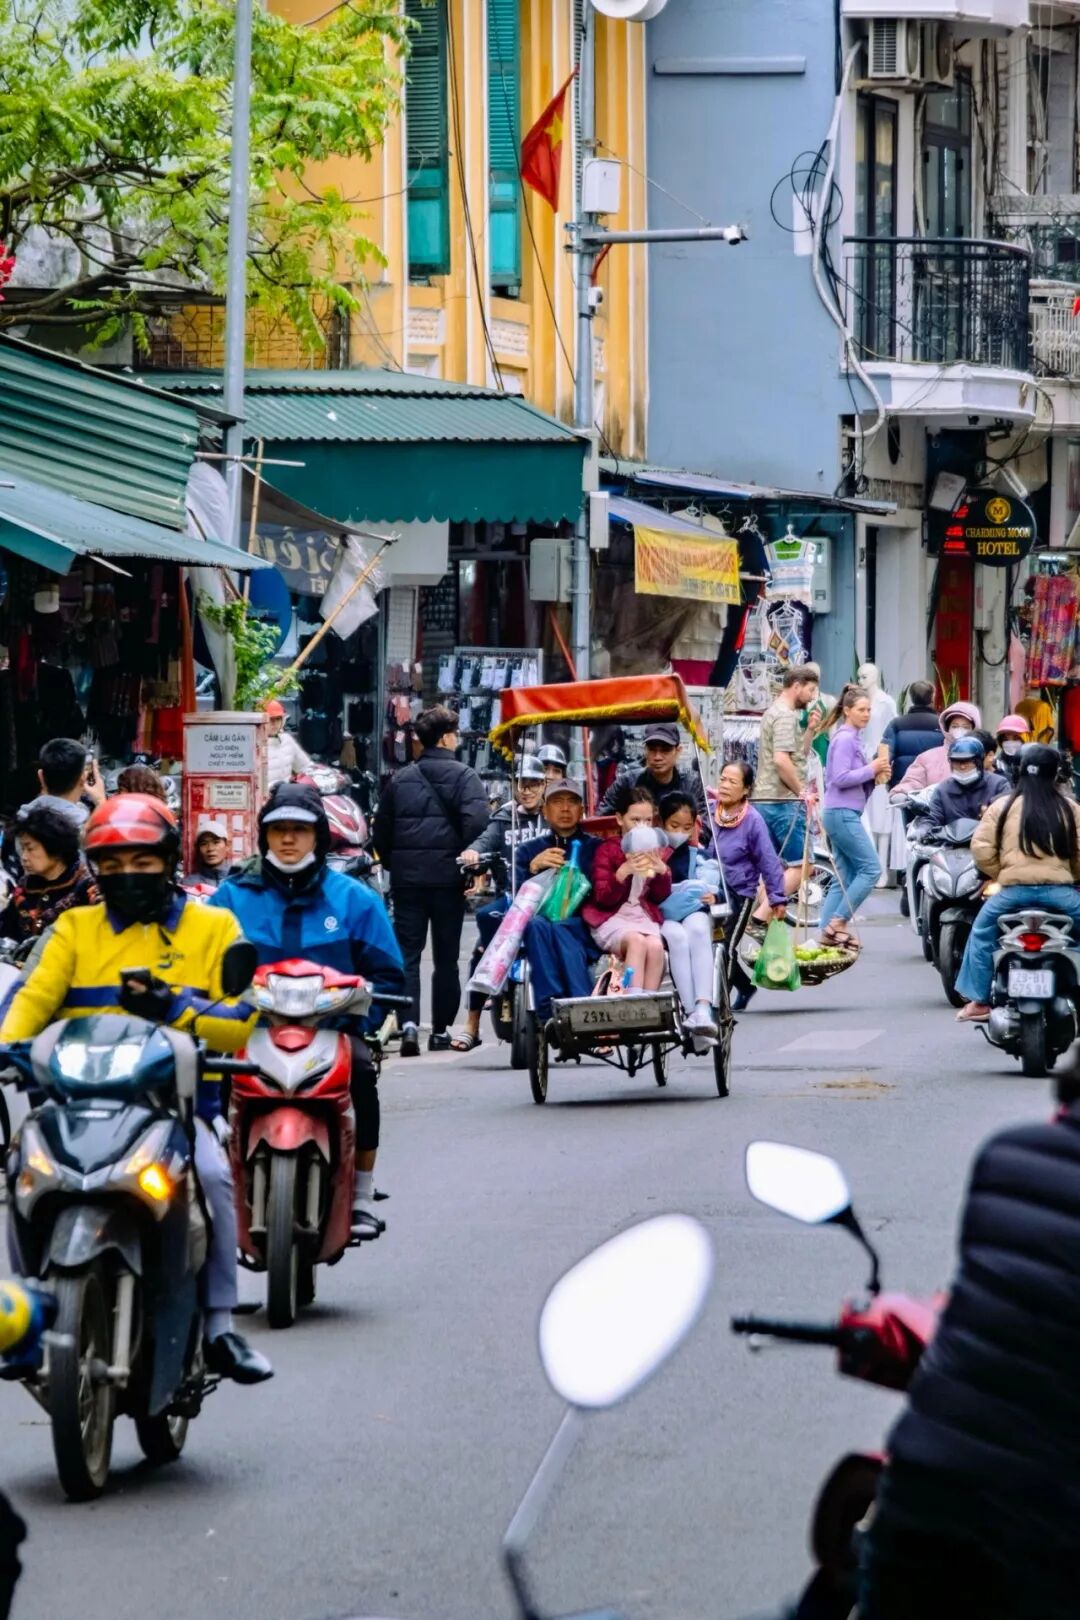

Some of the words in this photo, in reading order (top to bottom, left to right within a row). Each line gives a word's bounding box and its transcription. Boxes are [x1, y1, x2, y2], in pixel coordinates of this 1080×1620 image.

[993, 506, 1003, 515] M
[1007, 527, 1032, 538] MOON
[977, 542, 1020, 555] HOTEL
